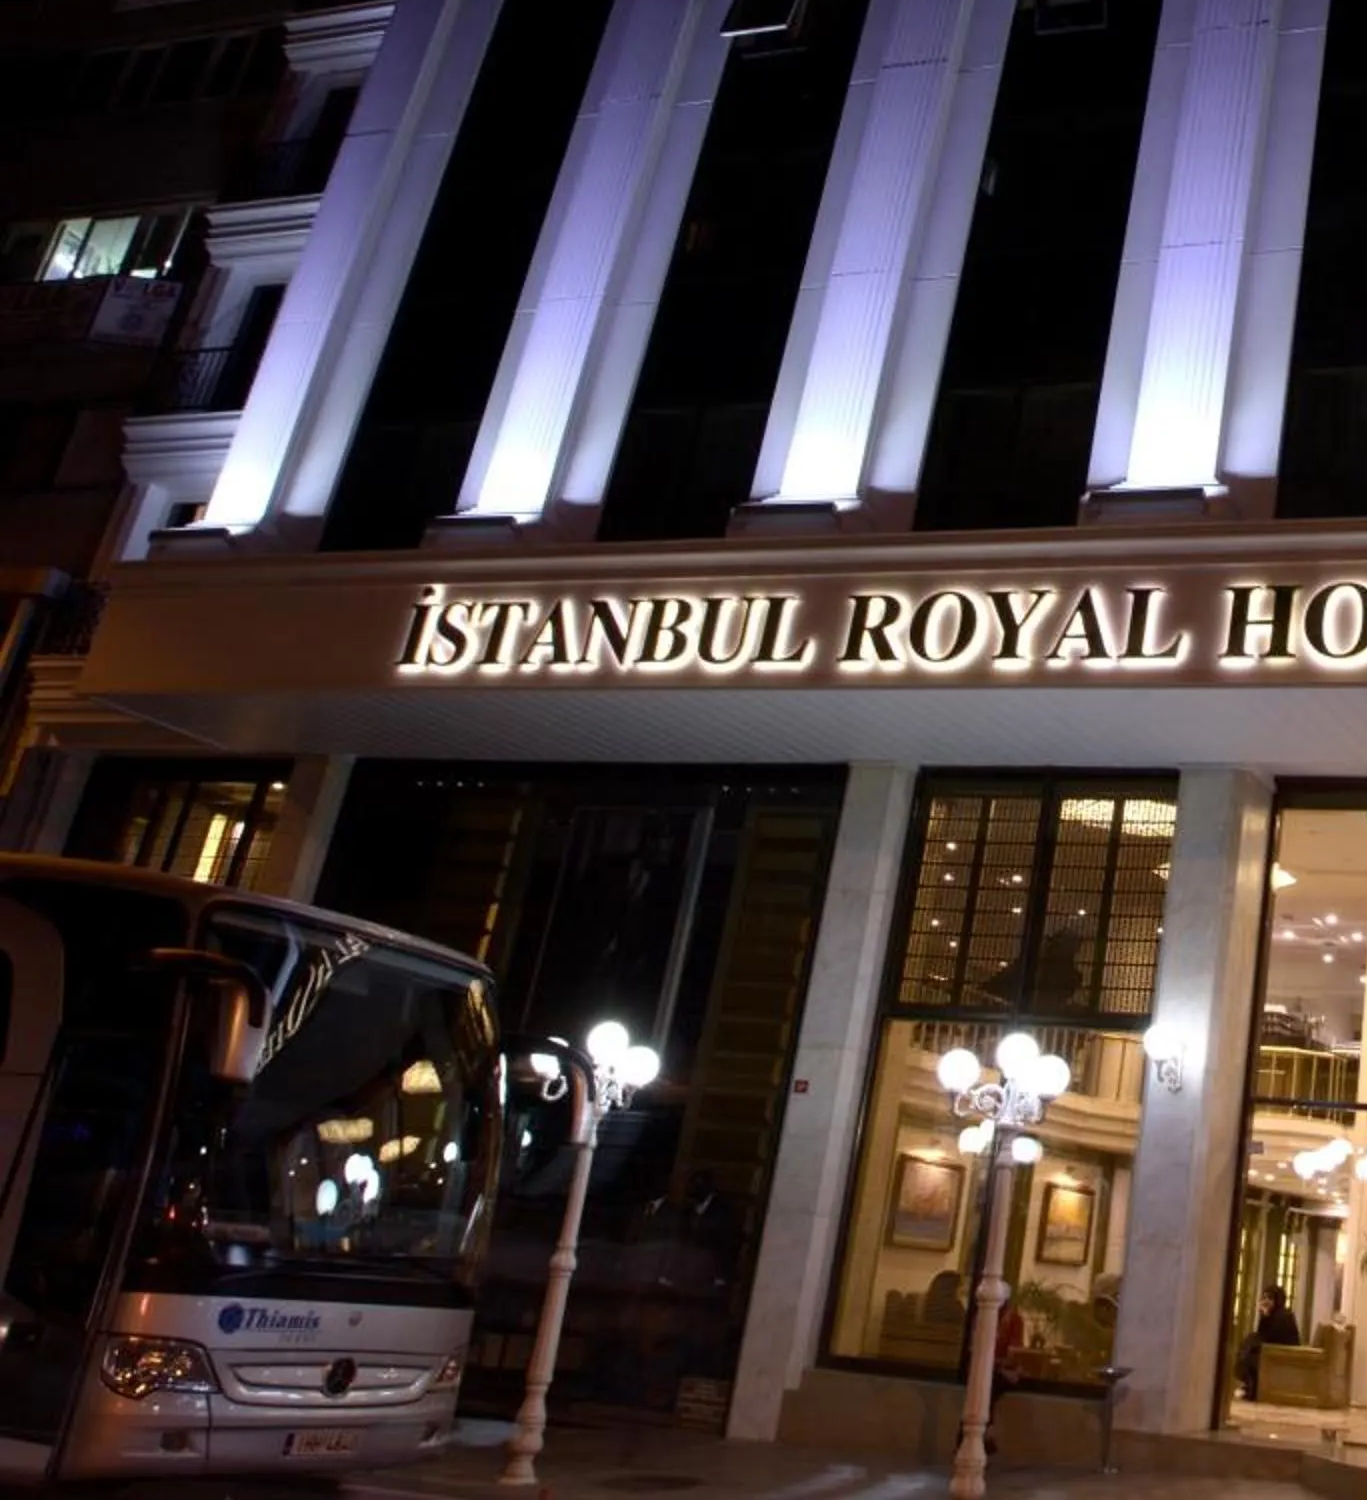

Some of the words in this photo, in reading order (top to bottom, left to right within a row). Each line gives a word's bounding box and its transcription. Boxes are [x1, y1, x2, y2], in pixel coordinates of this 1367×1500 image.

[395, 585, 810, 666] İSTANBUL
[837, 587, 1185, 663] ROYAL
[245, 1308, 321, 1330] Thiamis
